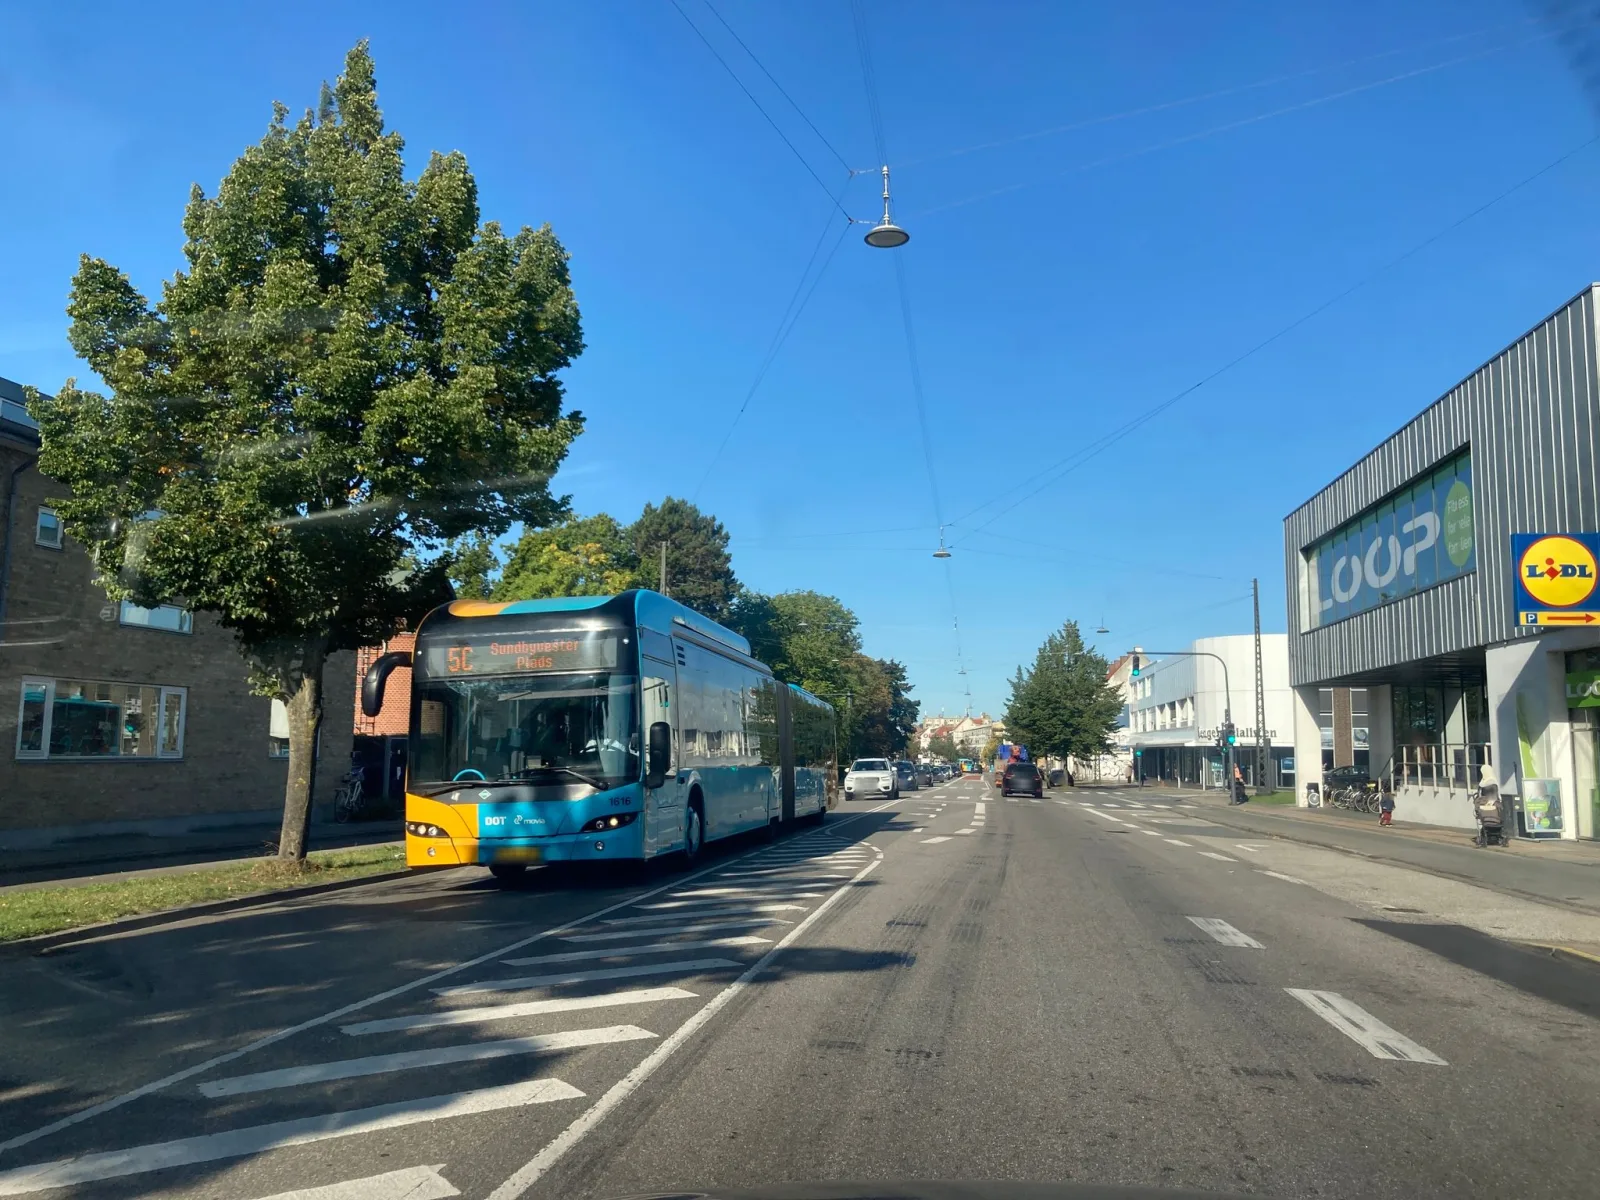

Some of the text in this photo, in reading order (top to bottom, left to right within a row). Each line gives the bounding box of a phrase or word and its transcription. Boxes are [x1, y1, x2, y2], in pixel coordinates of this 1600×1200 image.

[1311, 511, 1441, 613] LOOP
[1527, 613, 1536, 624] P
[490, 640, 578, 656] Sundbyvester
[448, 646, 473, 672] 5C
[517, 656, 552, 669] Plads
[609, 797, 631, 806] 1616
[485, 816, 545, 825] DOT movia
